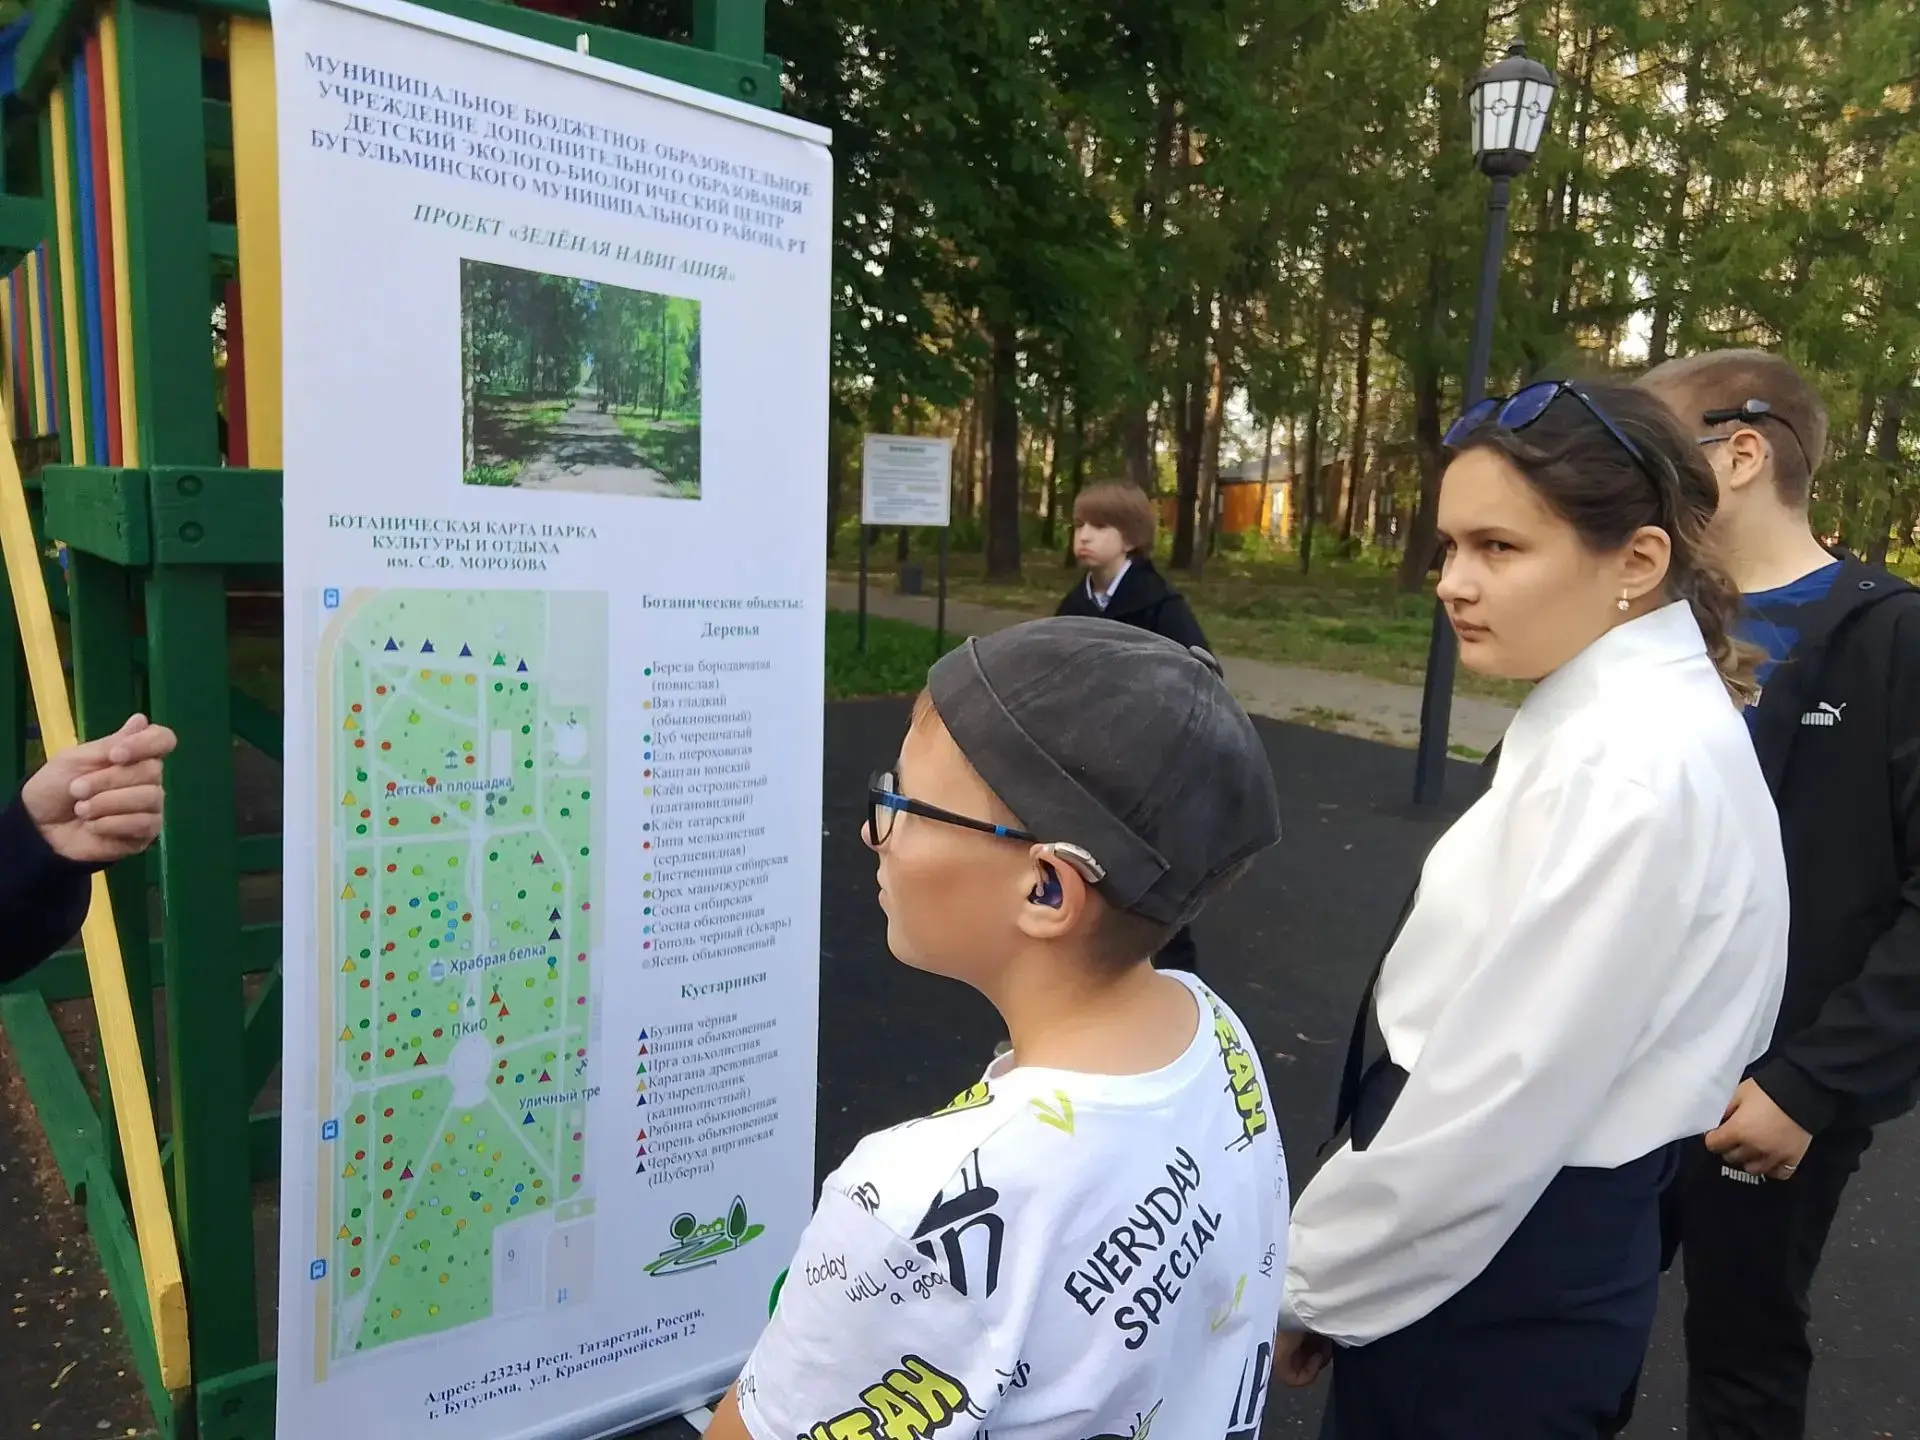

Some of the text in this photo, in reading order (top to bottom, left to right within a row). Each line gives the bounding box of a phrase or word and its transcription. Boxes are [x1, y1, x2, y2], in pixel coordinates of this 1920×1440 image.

[305, 52, 813, 197] МУНИЦИПАЛЬНОЕ БЮДЖЕТНОЕ ОБРАЗОВАТЕЛЬНОЕ
[318, 80, 802, 213] УЧРЕЖДЕНИЕ ДОПОЛНИТЕЛЬНОГО ОБРАЗОВАНИЯ
[344, 112, 784, 230] ДЕТСКИЙ ЭКОЛОГО-БИОЛОГИЧЕСКИЙ ЦЕНТР
[311, 128, 806, 254] БУГУЛЬМИНСКОГО МУНИЦИПАЛЬНОГО РАЙОНА РТ
[413, 203, 503, 235] ПРОЕКТ
[328, 514, 597, 539] БОТАНИЧЕСКАЯ КАРТА ПАРКА
[372, 535, 560, 555] КУЛЬТУРЫ И ОТДЫХА
[386, 558, 413, 568] им.
[460, 556, 547, 571] МОРОЗОВА
[642, 595, 742, 610] Ботанические
[700, 622, 760, 639] Деревья
[652, 695, 727, 709] Вяз гладкий
[652, 711, 752, 727] (обыкновенный)
[1801, 712, 1834, 726] UMA
[651, 732, 677, 747] Дуб
[653, 750, 675, 763] Ель
[652, 763, 750, 779] Каштан конский
[447, 776, 512, 792] площадка
[687, 776, 768, 796] остролистный
[651, 836, 683, 849] Липа
[651, 887, 683, 902] Орех
[651, 894, 753, 917] Сосна сибирская
[651, 920, 690, 934] Сосна
[652, 936, 696, 952] Тополь
[450, 944, 547, 974] Храбрая белка
[651, 954, 688, 969] Ясень
[681, 972, 767, 1000] Кустарники
[452, 1019, 488, 1036] ПКиО
[650, 1023, 693, 1040] Бузина
[650, 1018, 777, 1055] Вишня обыкновенная
[648, 1057, 679, 1074] Ирга
[649, 1069, 706, 1088] Карагана
[649, 1074, 745, 1105] Пузыреплодник
[519, 1090, 576, 1110] Уличный
[649, 1098, 778, 1138] Рябина обыкновенная
[648, 1113, 779, 1155] Сирень обыкновенная
[647, 1149, 708, 1173] Черёмуха
[648, 1160, 715, 1188] (Шуберта)
[1064, 1146, 1201, 1316] EVERYDAY
[805, 1252, 848, 1287] today
[1114, 1203, 1222, 1350] SPECIAL
[845, 1257, 921, 1304] will be
[890, 1291, 906, 1305] a
[556, 1332, 679, 1378] Красноармейская
[683, 1324, 697, 1336] 12
[424, 1379, 476, 1406] Адрес:
[480, 1361, 531, 1386] 423234
[536, 1351, 573, 1370] Респ.
